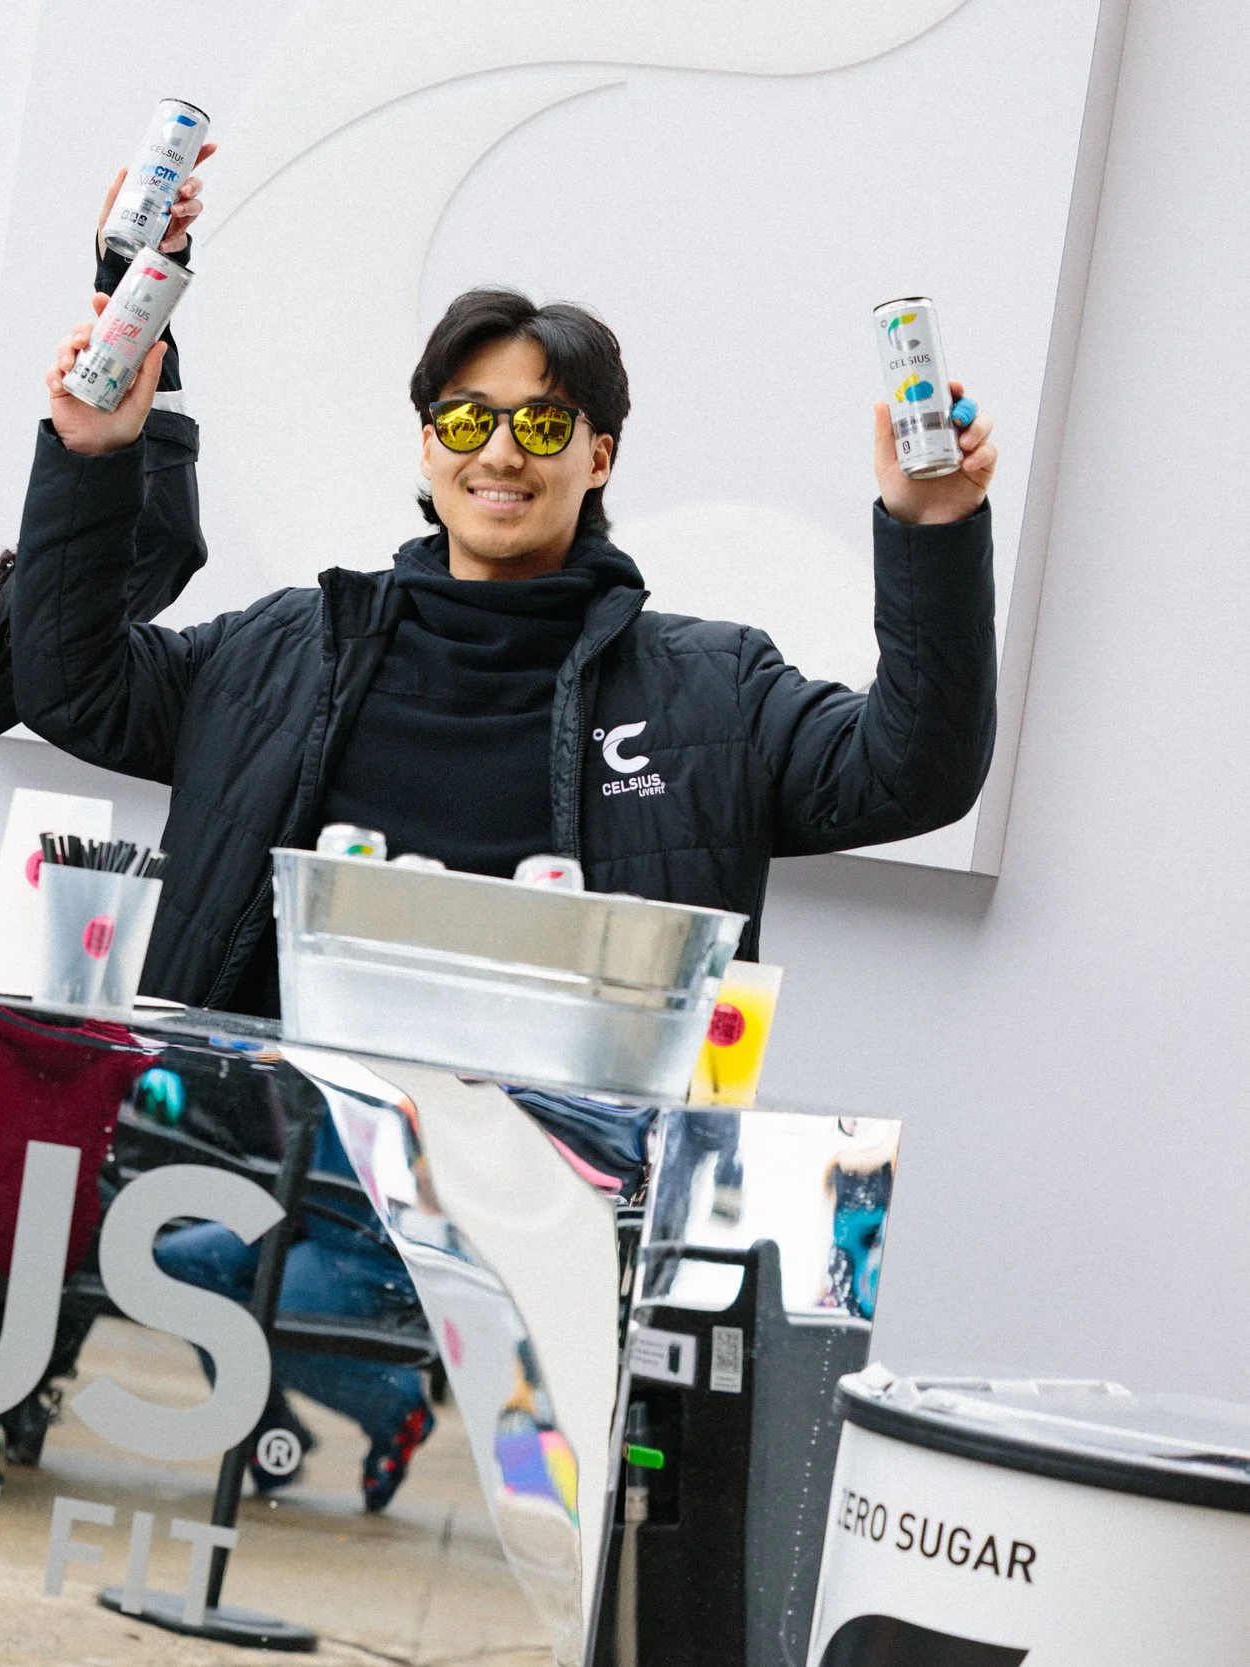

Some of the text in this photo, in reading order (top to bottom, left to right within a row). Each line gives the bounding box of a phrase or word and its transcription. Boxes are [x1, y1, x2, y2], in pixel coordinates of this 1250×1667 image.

[889, 353, 932, 370] CELSIUS
[602, 773, 661, 797] CELSIUS
[638, 786, 665, 797] LIVE FIT
[895, 1512, 1037, 1584] SUGAR
[43, 1495, 239, 1627] FIT
